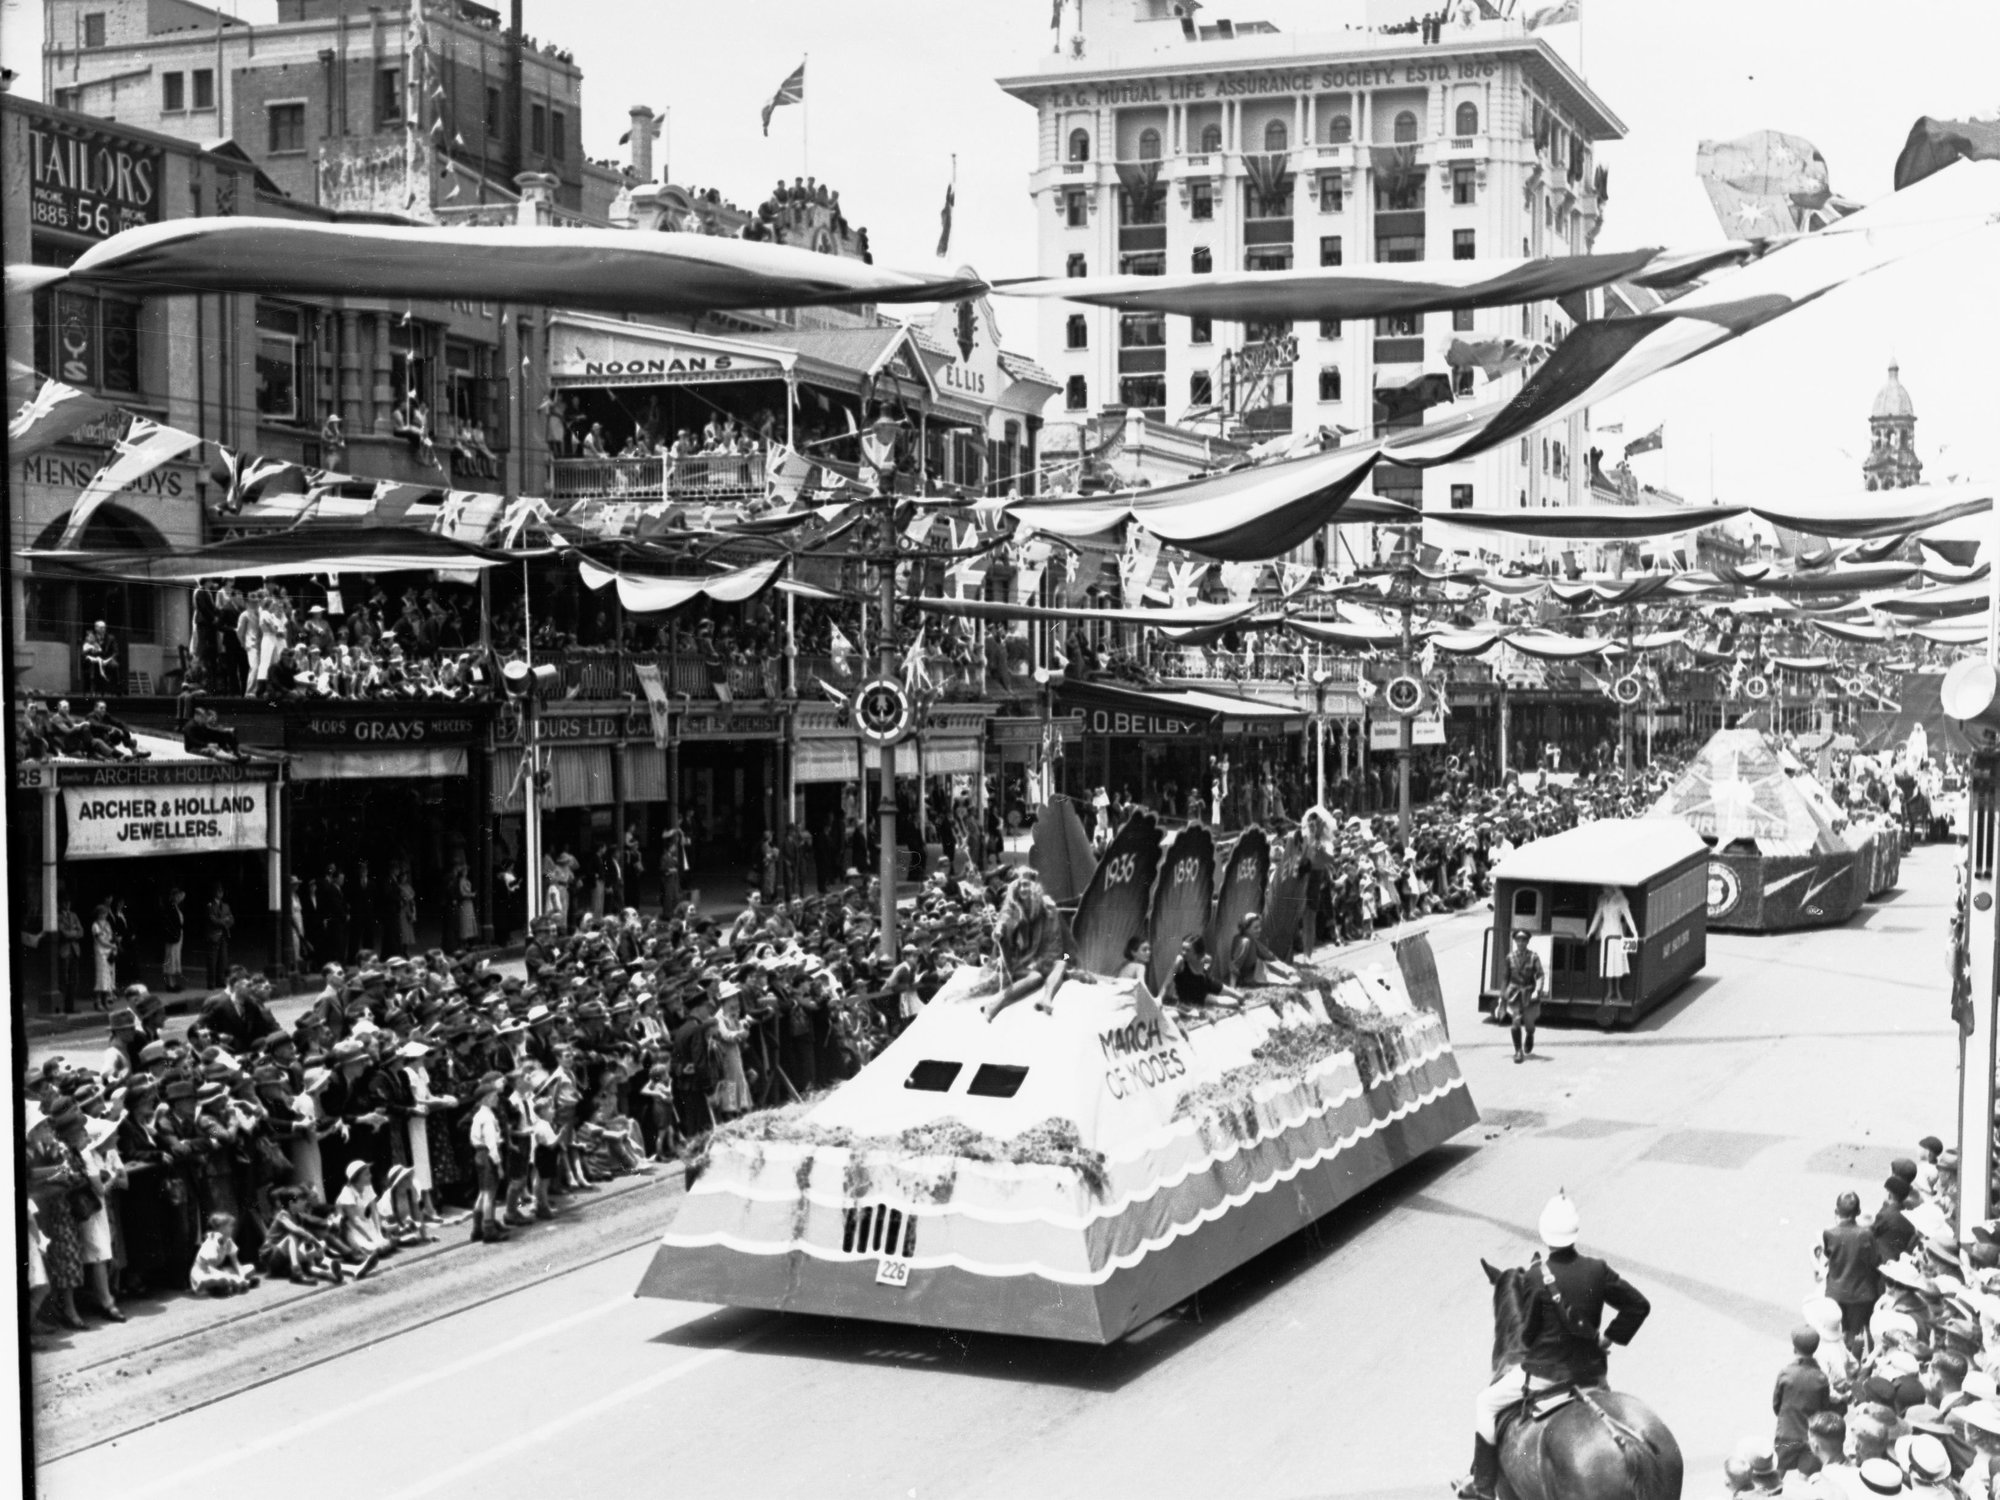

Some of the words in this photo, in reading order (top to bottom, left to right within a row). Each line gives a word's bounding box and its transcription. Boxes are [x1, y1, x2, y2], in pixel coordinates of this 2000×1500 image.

[1097, 85, 1161, 105] MUTUAL
[1170, 81, 1206, 100] LIFE
[1215, 73, 1313, 97] ASSURANCE
[29, 129, 152, 206] TAILORS
[32, 200, 69, 227] 1885
[77, 197, 110, 235] 56
[946, 364, 985, 394] ELLIS
[355, 711, 425, 741] GRAYS
[588, 717, 619, 737] LTD.
[93, 767, 159, 785] ARCHER
[164, 770, 171, 782] &
[175, 764, 243, 783] HOLLAND
[78, 800, 157, 821] ARCHER
[161, 800, 172, 818] &
[174, 796, 255, 817] HOLLAND
[116, 819, 223, 842] JEWELLERS.
[1104, 852, 1137, 892] 1936
[1174, 857, 1200, 888] 1890
[1098, 1017, 1164, 1063] MARCH
[1105, 1066, 1131, 1100] OF
[1125, 1047, 1186, 1091] MODES
[881, 1260, 907, 1281] 226
